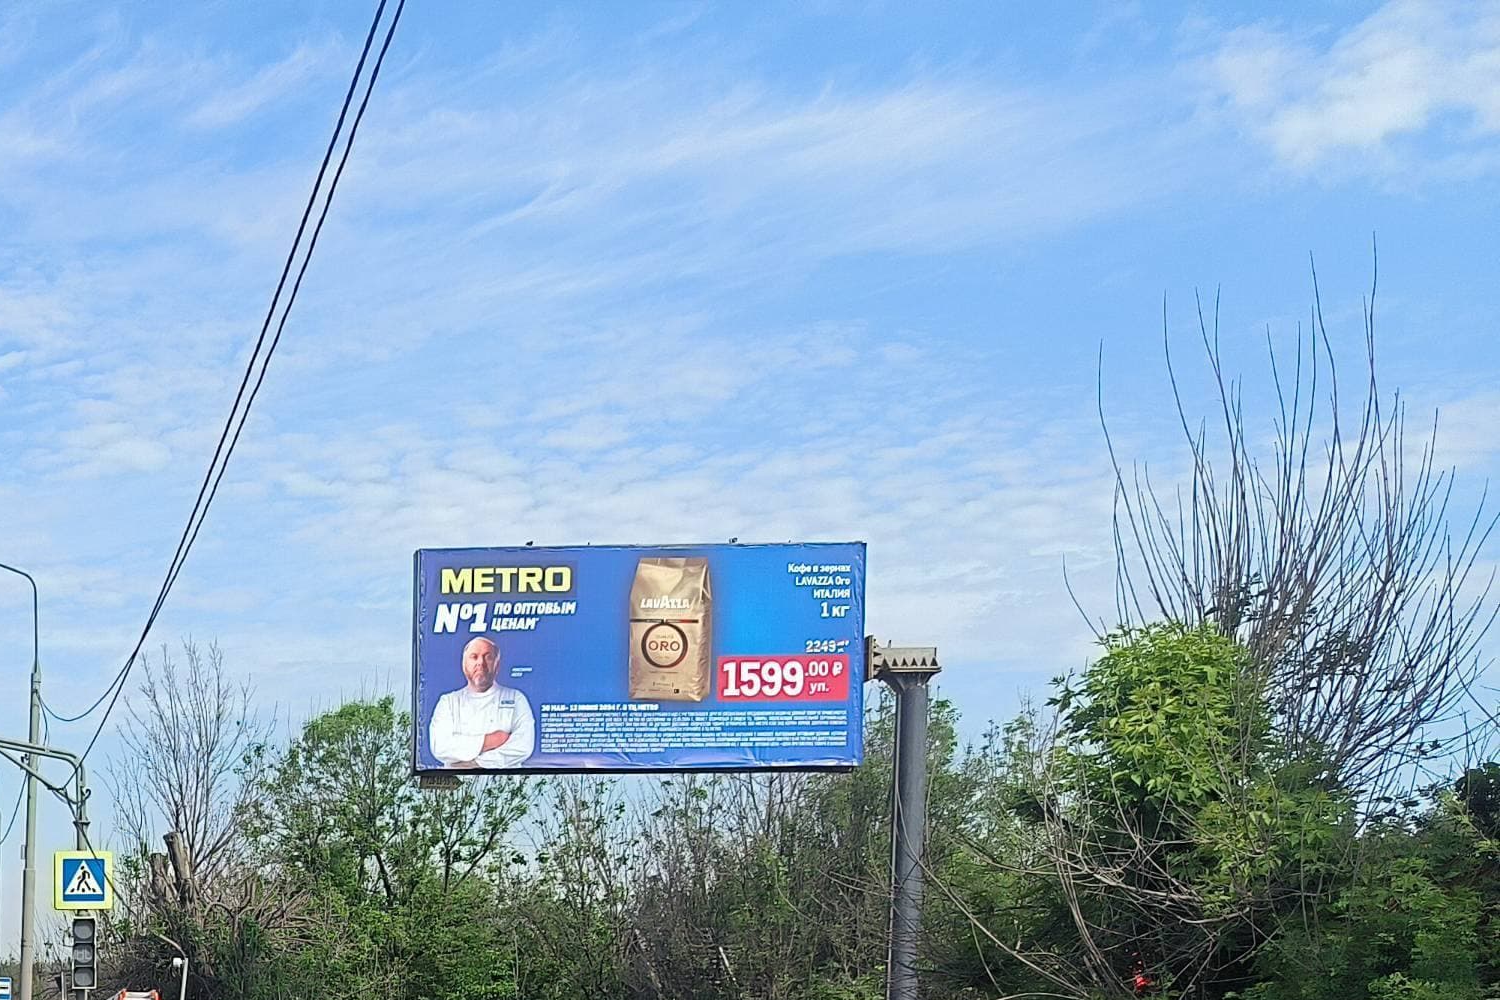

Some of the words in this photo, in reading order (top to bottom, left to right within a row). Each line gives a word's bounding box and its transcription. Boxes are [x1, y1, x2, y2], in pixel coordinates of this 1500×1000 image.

[787, 563, 812, 575] Кофе
[813, 565, 819, 573] в
[820, 564, 851, 575] зернах
[441, 566, 572, 594] METRO
[795, 576, 834, 586] LAVAZZA
[835, 575, 851, 586] Oro
[813, 588, 851, 599] ИТАЛИЯ
[493, 602, 511, 615] ПО
[513, 601, 577, 615] ОПТОВЫМ
[640, 595, 690, 609] LAVAZZA
[820, 602, 830, 618] 1
[832, 605, 850, 618] кг
[648, 640, 681, 652] ORO
[809, 682, 830, 695] уп.
